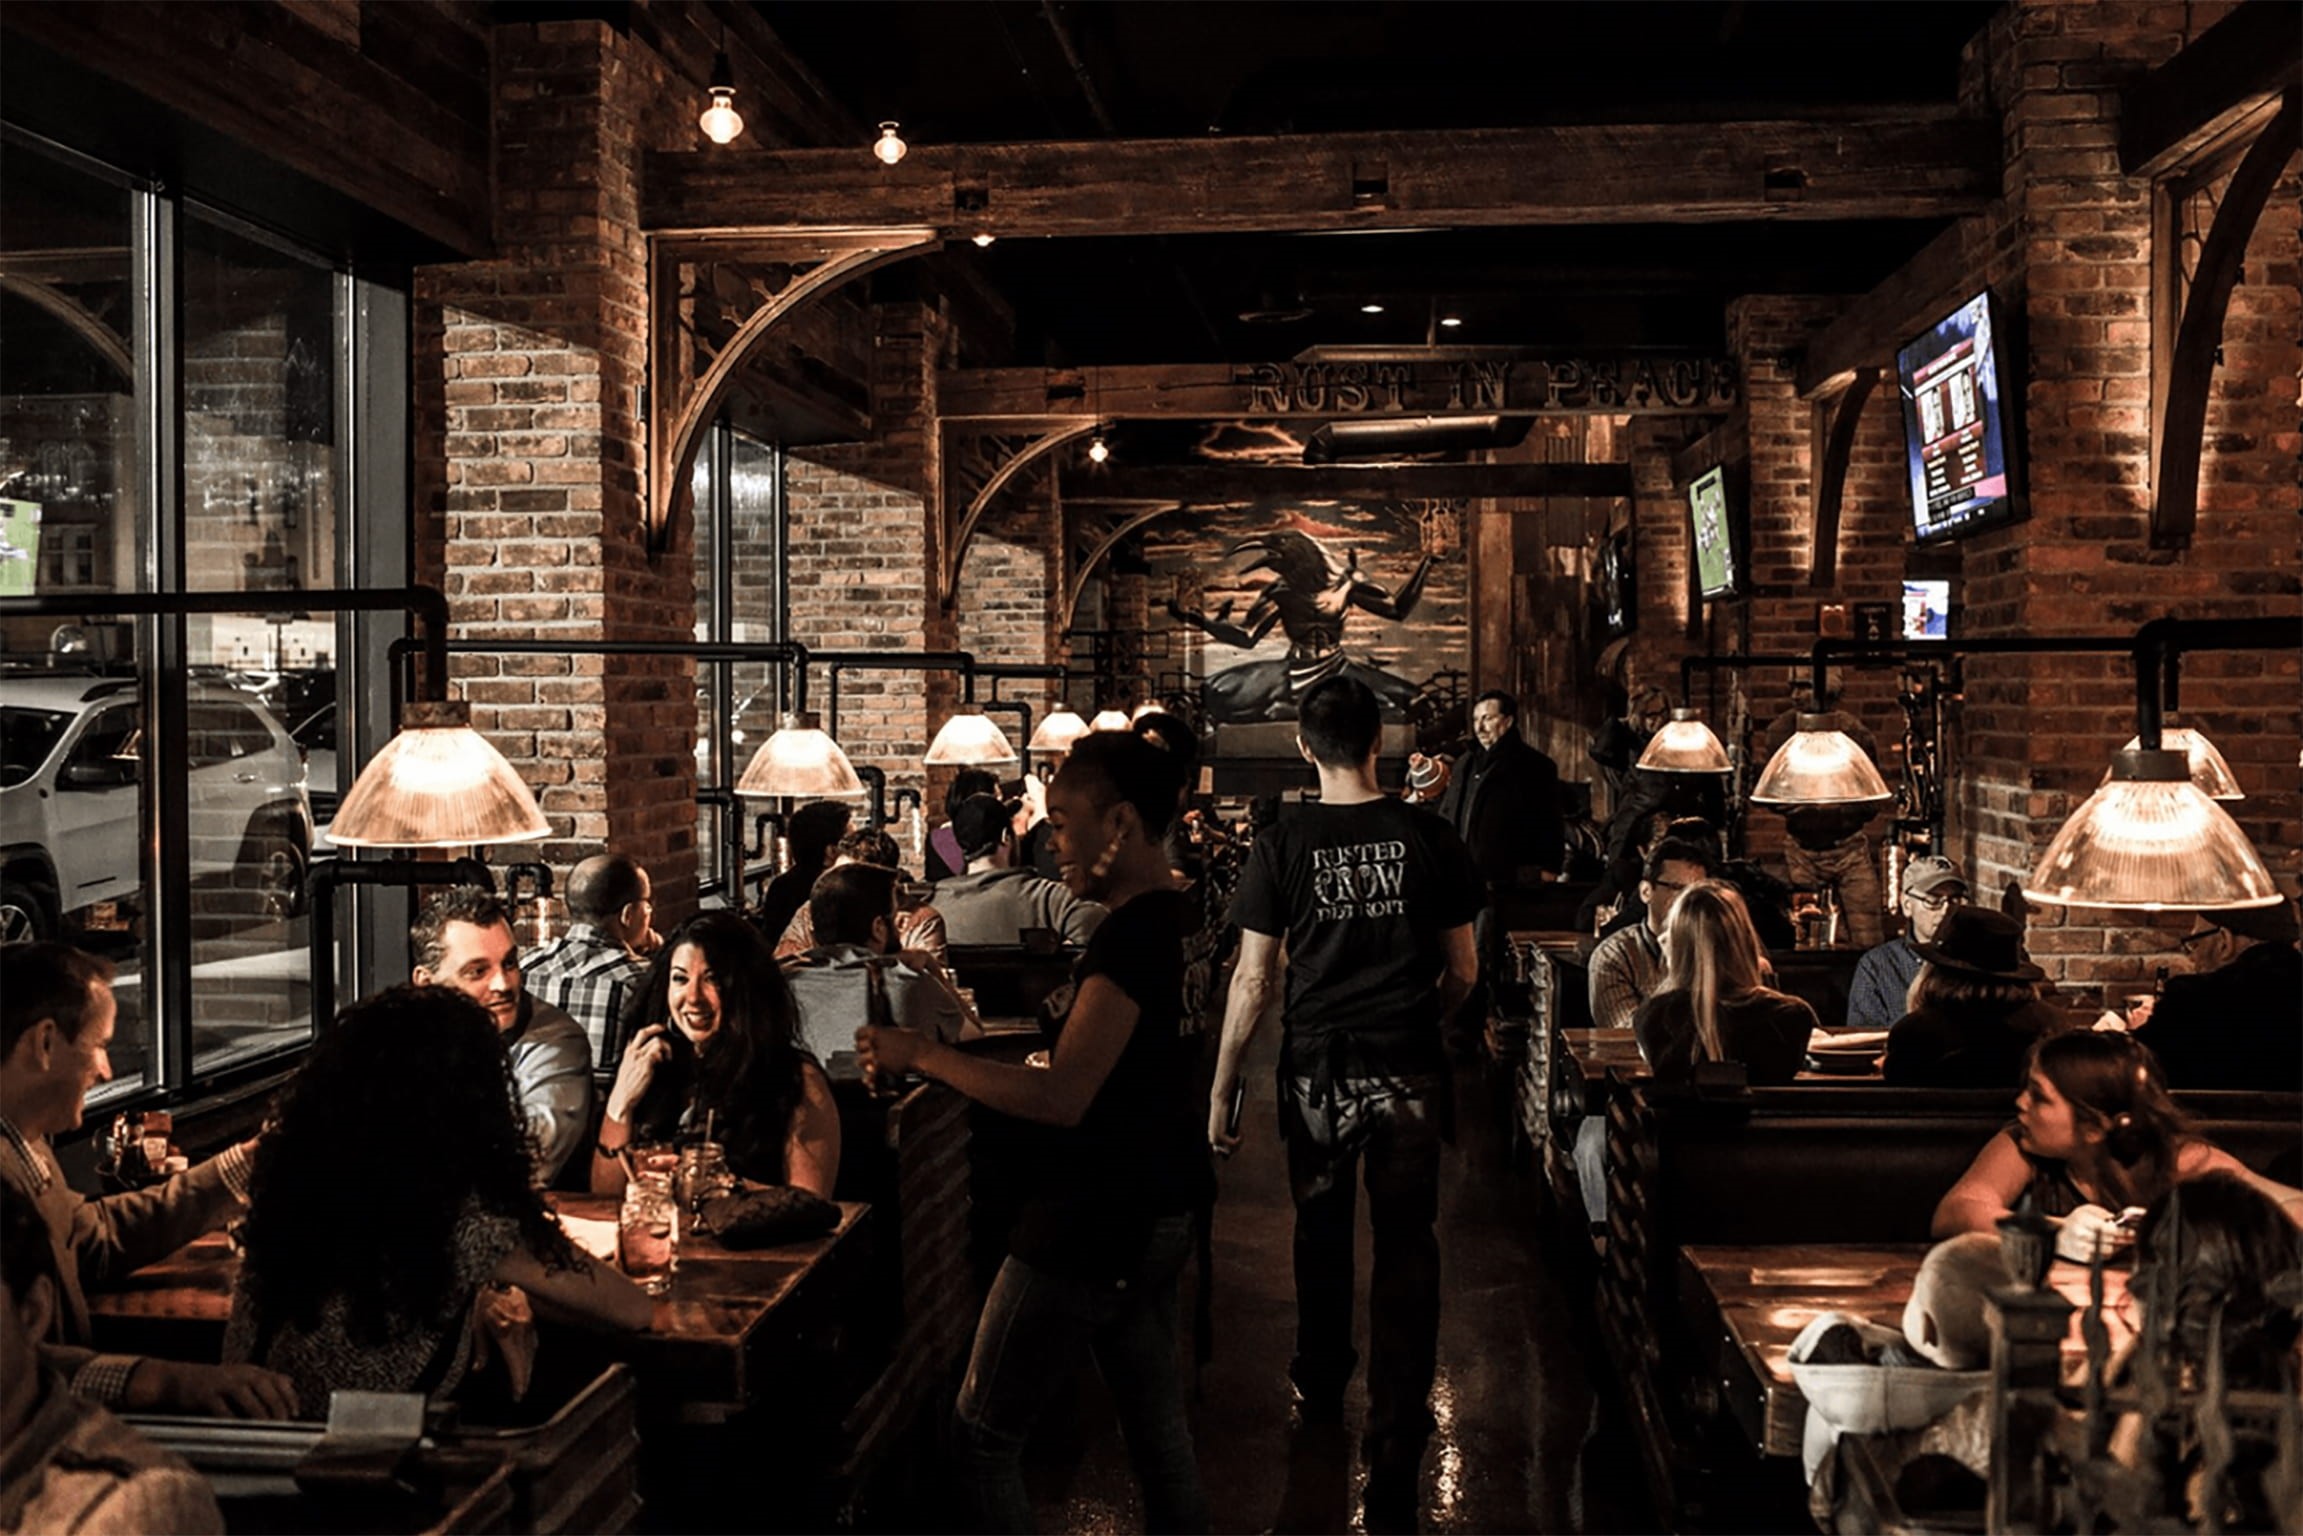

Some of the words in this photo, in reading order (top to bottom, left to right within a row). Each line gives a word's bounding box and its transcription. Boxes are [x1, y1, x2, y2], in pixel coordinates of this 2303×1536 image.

[1247, 361, 1411, 411] RUST
[1446, 361, 1508, 410] IN
[1542, 359, 1738, 408] PEACE
[1312, 840, 1406, 870] RUSTED
[1313, 861, 1408, 906] CROW
